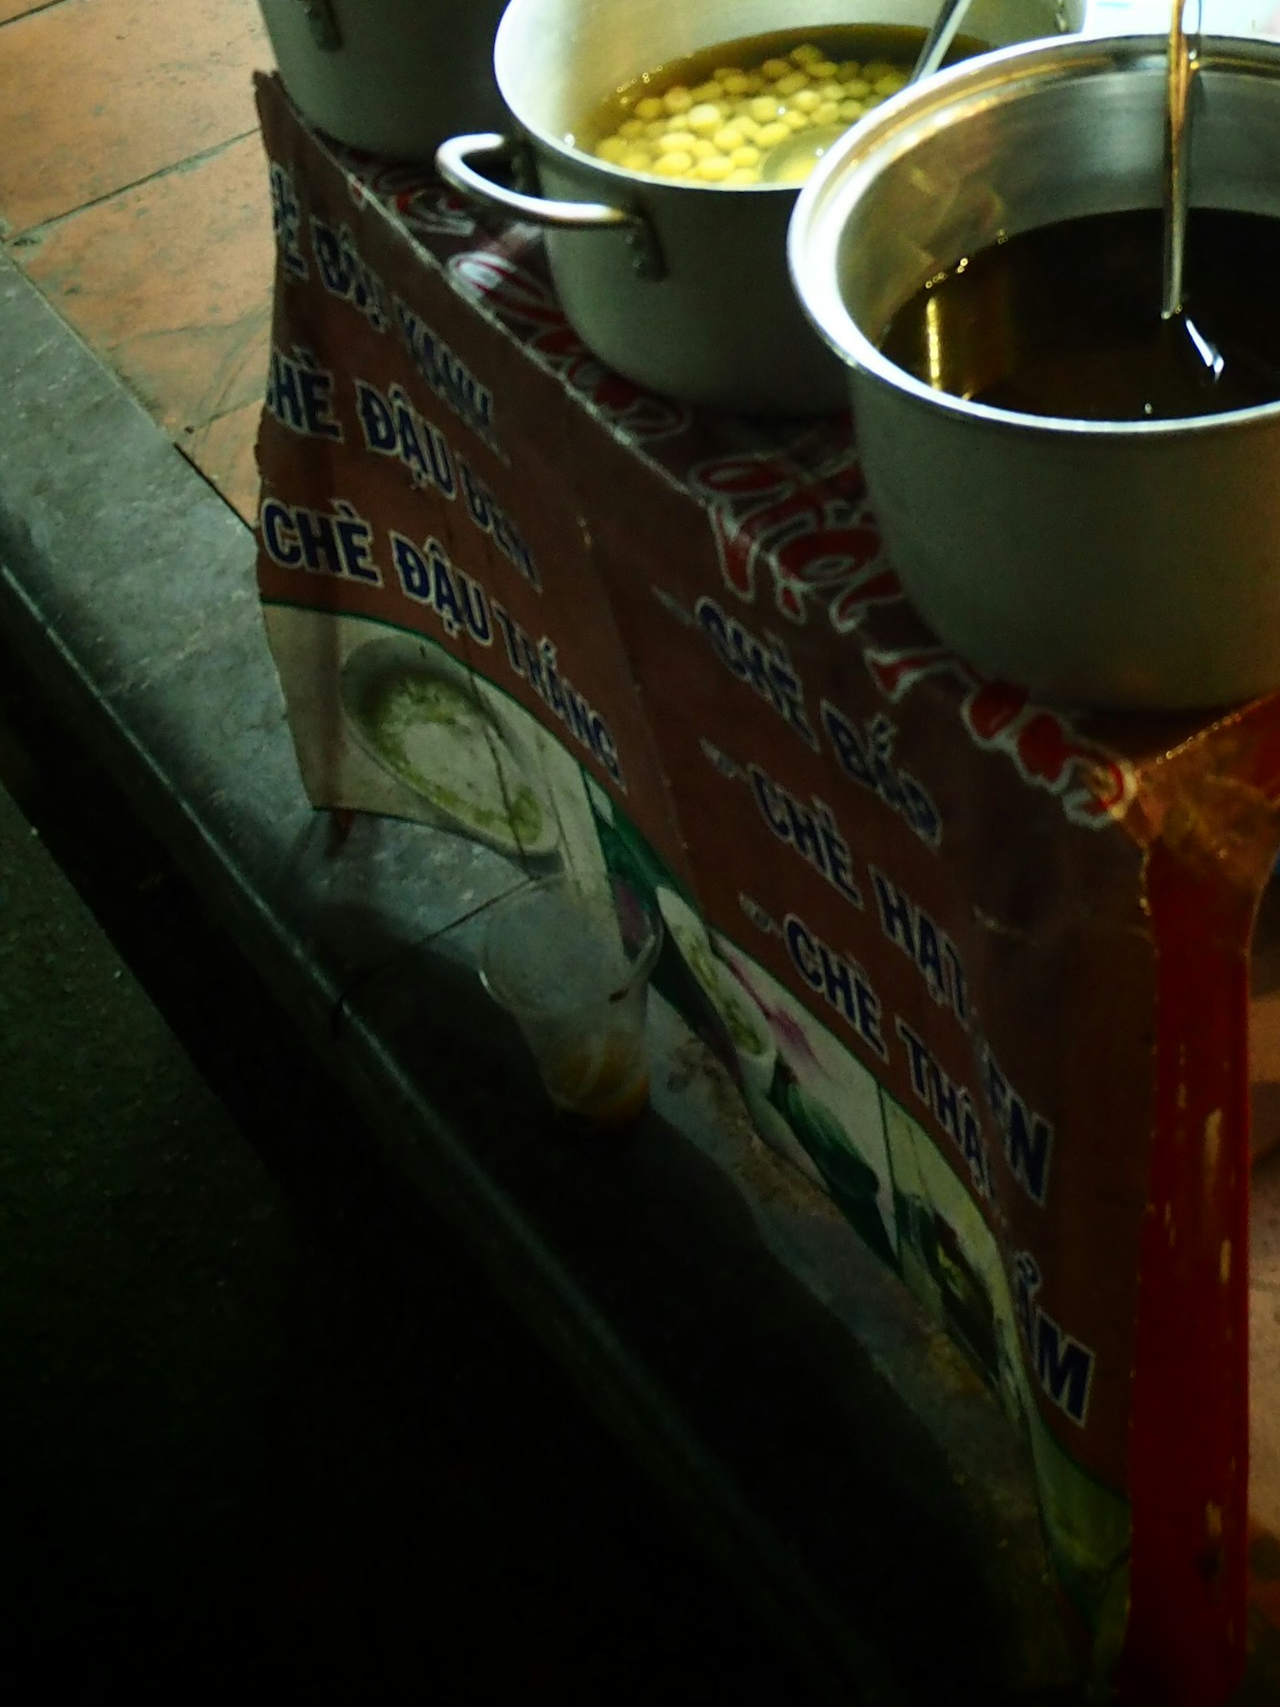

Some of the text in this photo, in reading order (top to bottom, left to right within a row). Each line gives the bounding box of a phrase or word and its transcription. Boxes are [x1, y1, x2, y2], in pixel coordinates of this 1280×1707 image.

[268, 344, 345, 443] HÈ
[354, 381, 457, 501] ĐẬU
[261, 497, 385, 589] CHÈ
[389, 529, 493, 647] ĐẬU
[695, 596, 821, 755] CHÈ
[746, 762, 866, 912] CHÈ
[783, 913, 890, 1065] CHÈ
